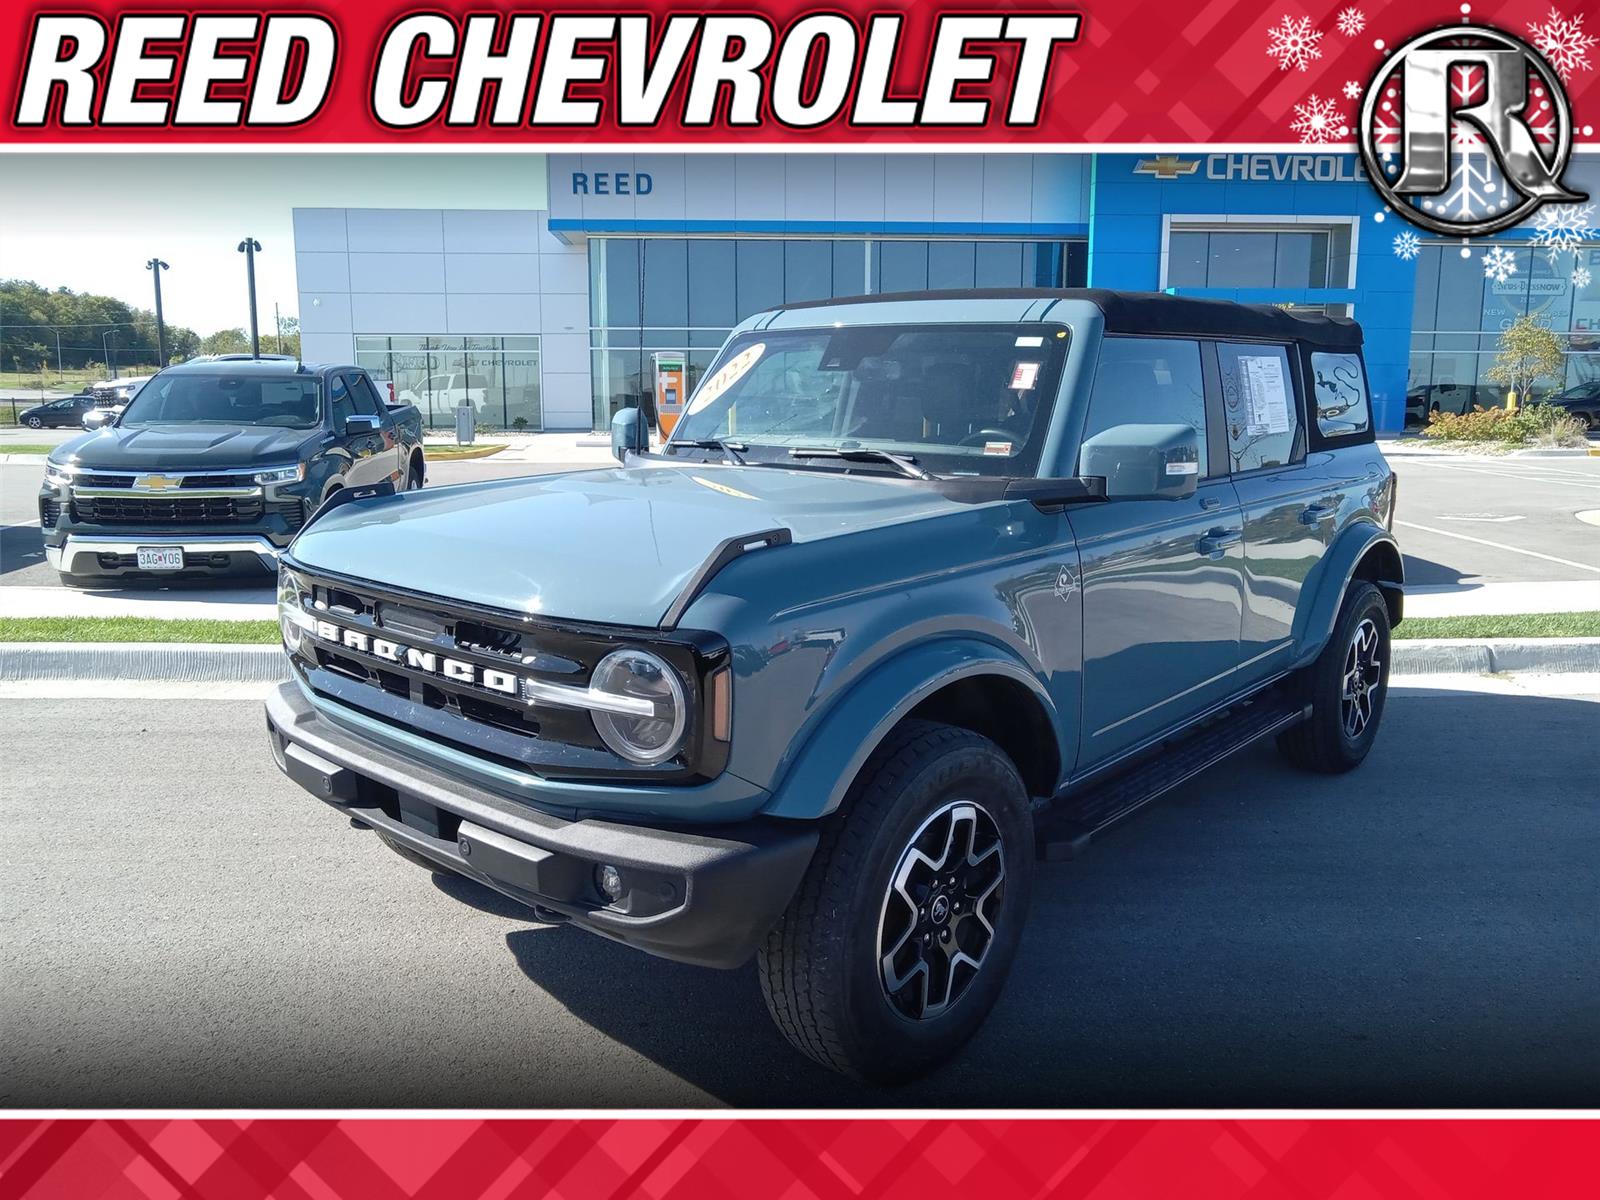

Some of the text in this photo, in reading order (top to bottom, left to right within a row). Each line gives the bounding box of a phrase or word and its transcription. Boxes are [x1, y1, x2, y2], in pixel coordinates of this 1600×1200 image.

[1206, 153, 1371, 182] CHEVROLE
[572, 172, 653, 195] REED
[481, 359, 537, 367] CHEVROLET
[317, 620, 521, 695] BRONCO
